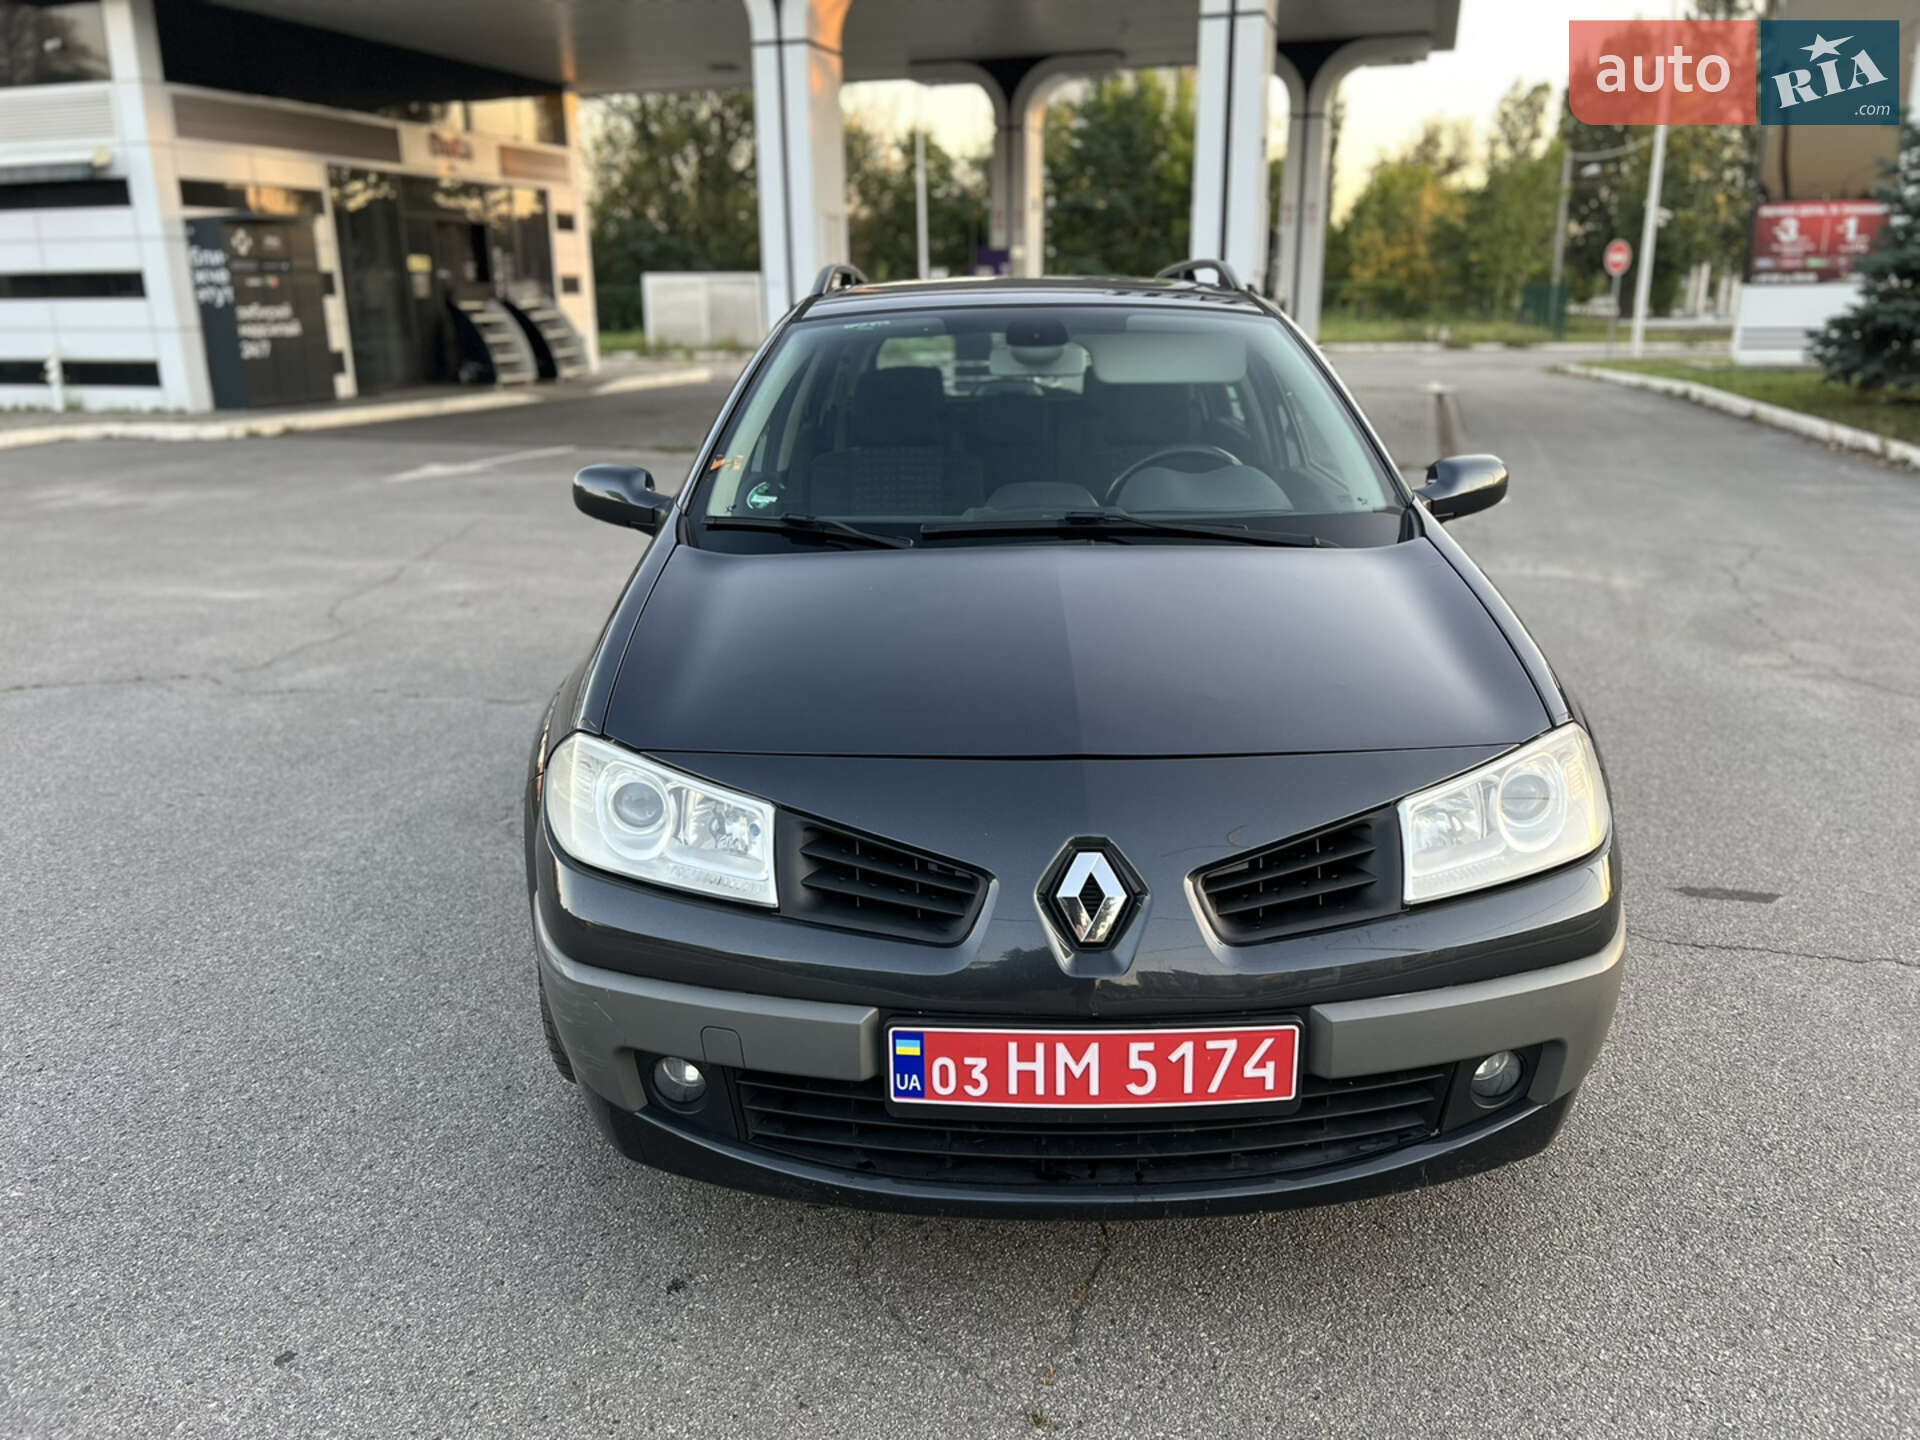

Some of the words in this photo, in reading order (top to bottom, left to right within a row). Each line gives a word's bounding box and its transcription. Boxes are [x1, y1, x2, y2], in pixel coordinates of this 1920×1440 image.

[896, 1073, 921, 1091] UA
[931, 1056, 989, 1097] 03
[1007, 1041, 1099, 1096] HM
[1125, 1037, 1275, 1095] 5174
